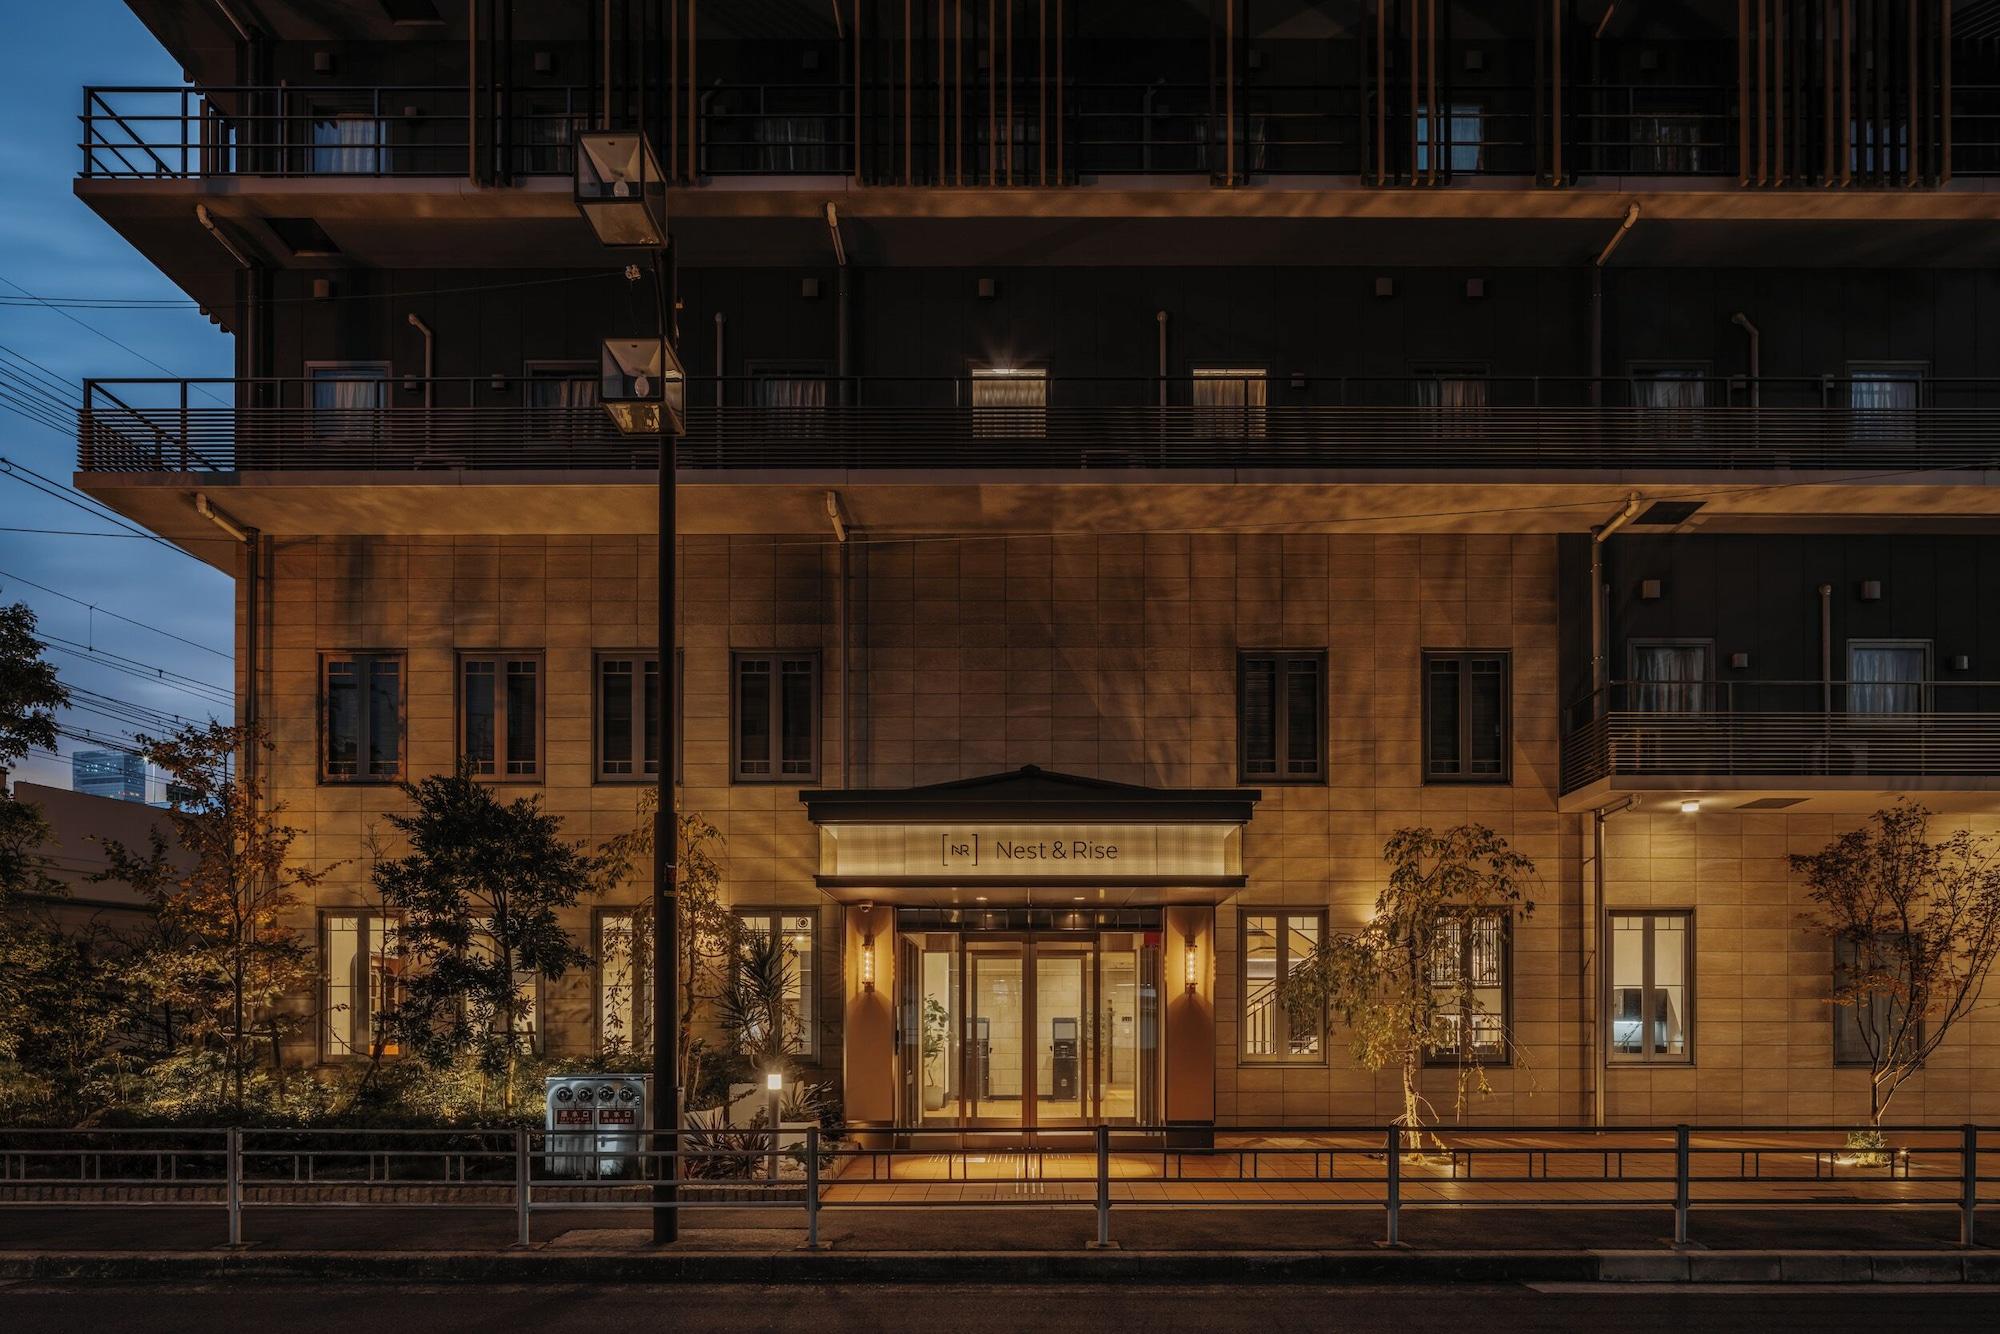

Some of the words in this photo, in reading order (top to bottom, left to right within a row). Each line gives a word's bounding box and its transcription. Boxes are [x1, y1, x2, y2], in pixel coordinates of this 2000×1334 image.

[996, 841, 1047, 859] Nest
[1052, 840, 1067, 859] &
[1073, 841, 1118, 859] Rise
